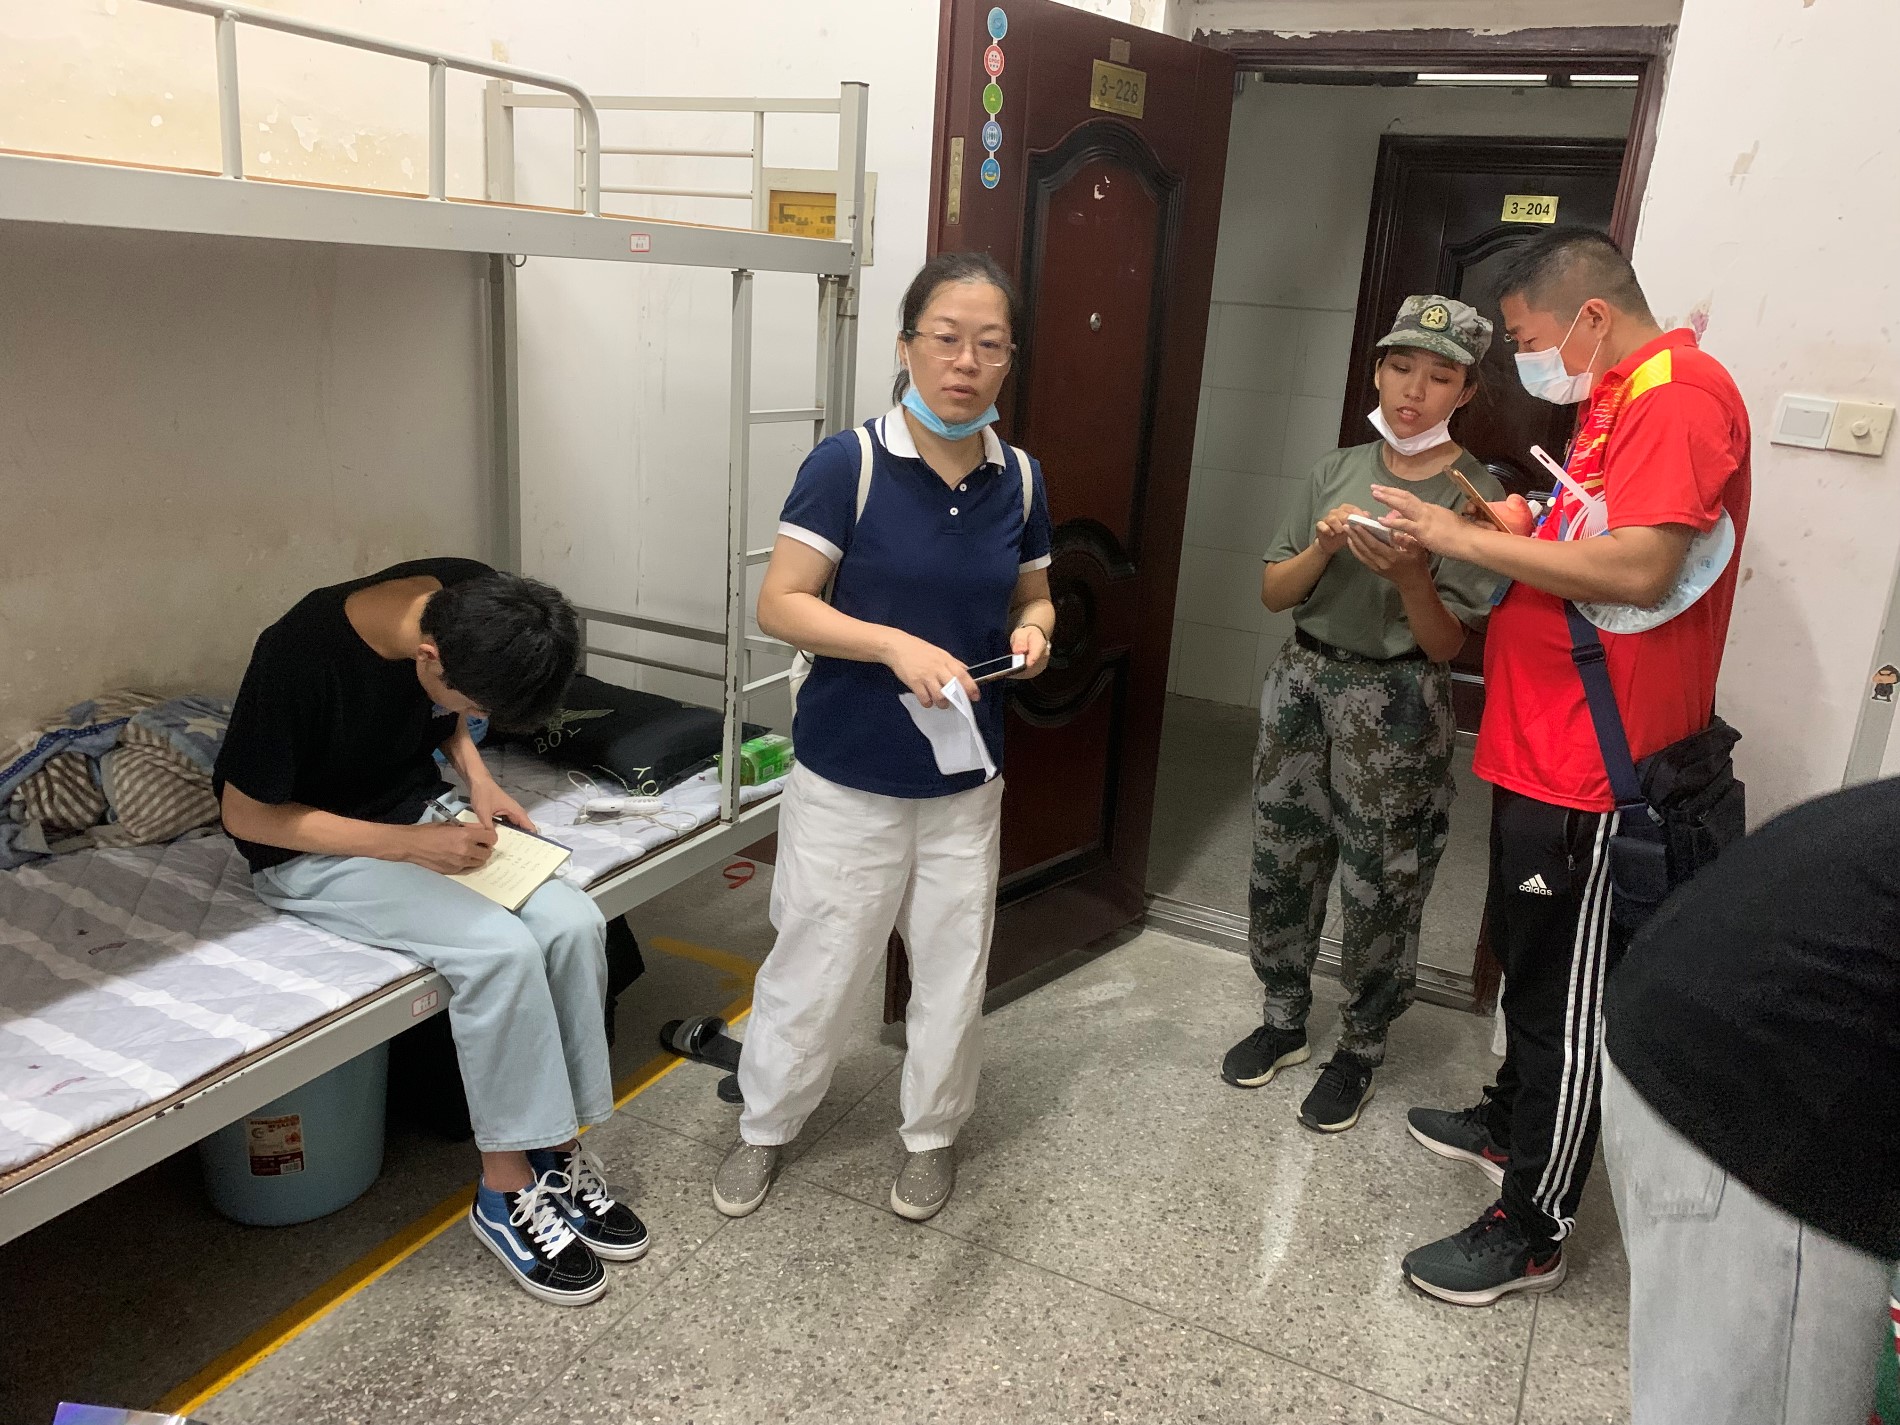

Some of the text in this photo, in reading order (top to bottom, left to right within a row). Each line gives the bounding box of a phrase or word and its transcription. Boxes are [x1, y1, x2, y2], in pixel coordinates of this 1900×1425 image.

[1100, 75, 1139, 104] 3-228
[1510, 202, 1550, 216] 3-204
[1518, 884, 1553, 896] adidas
